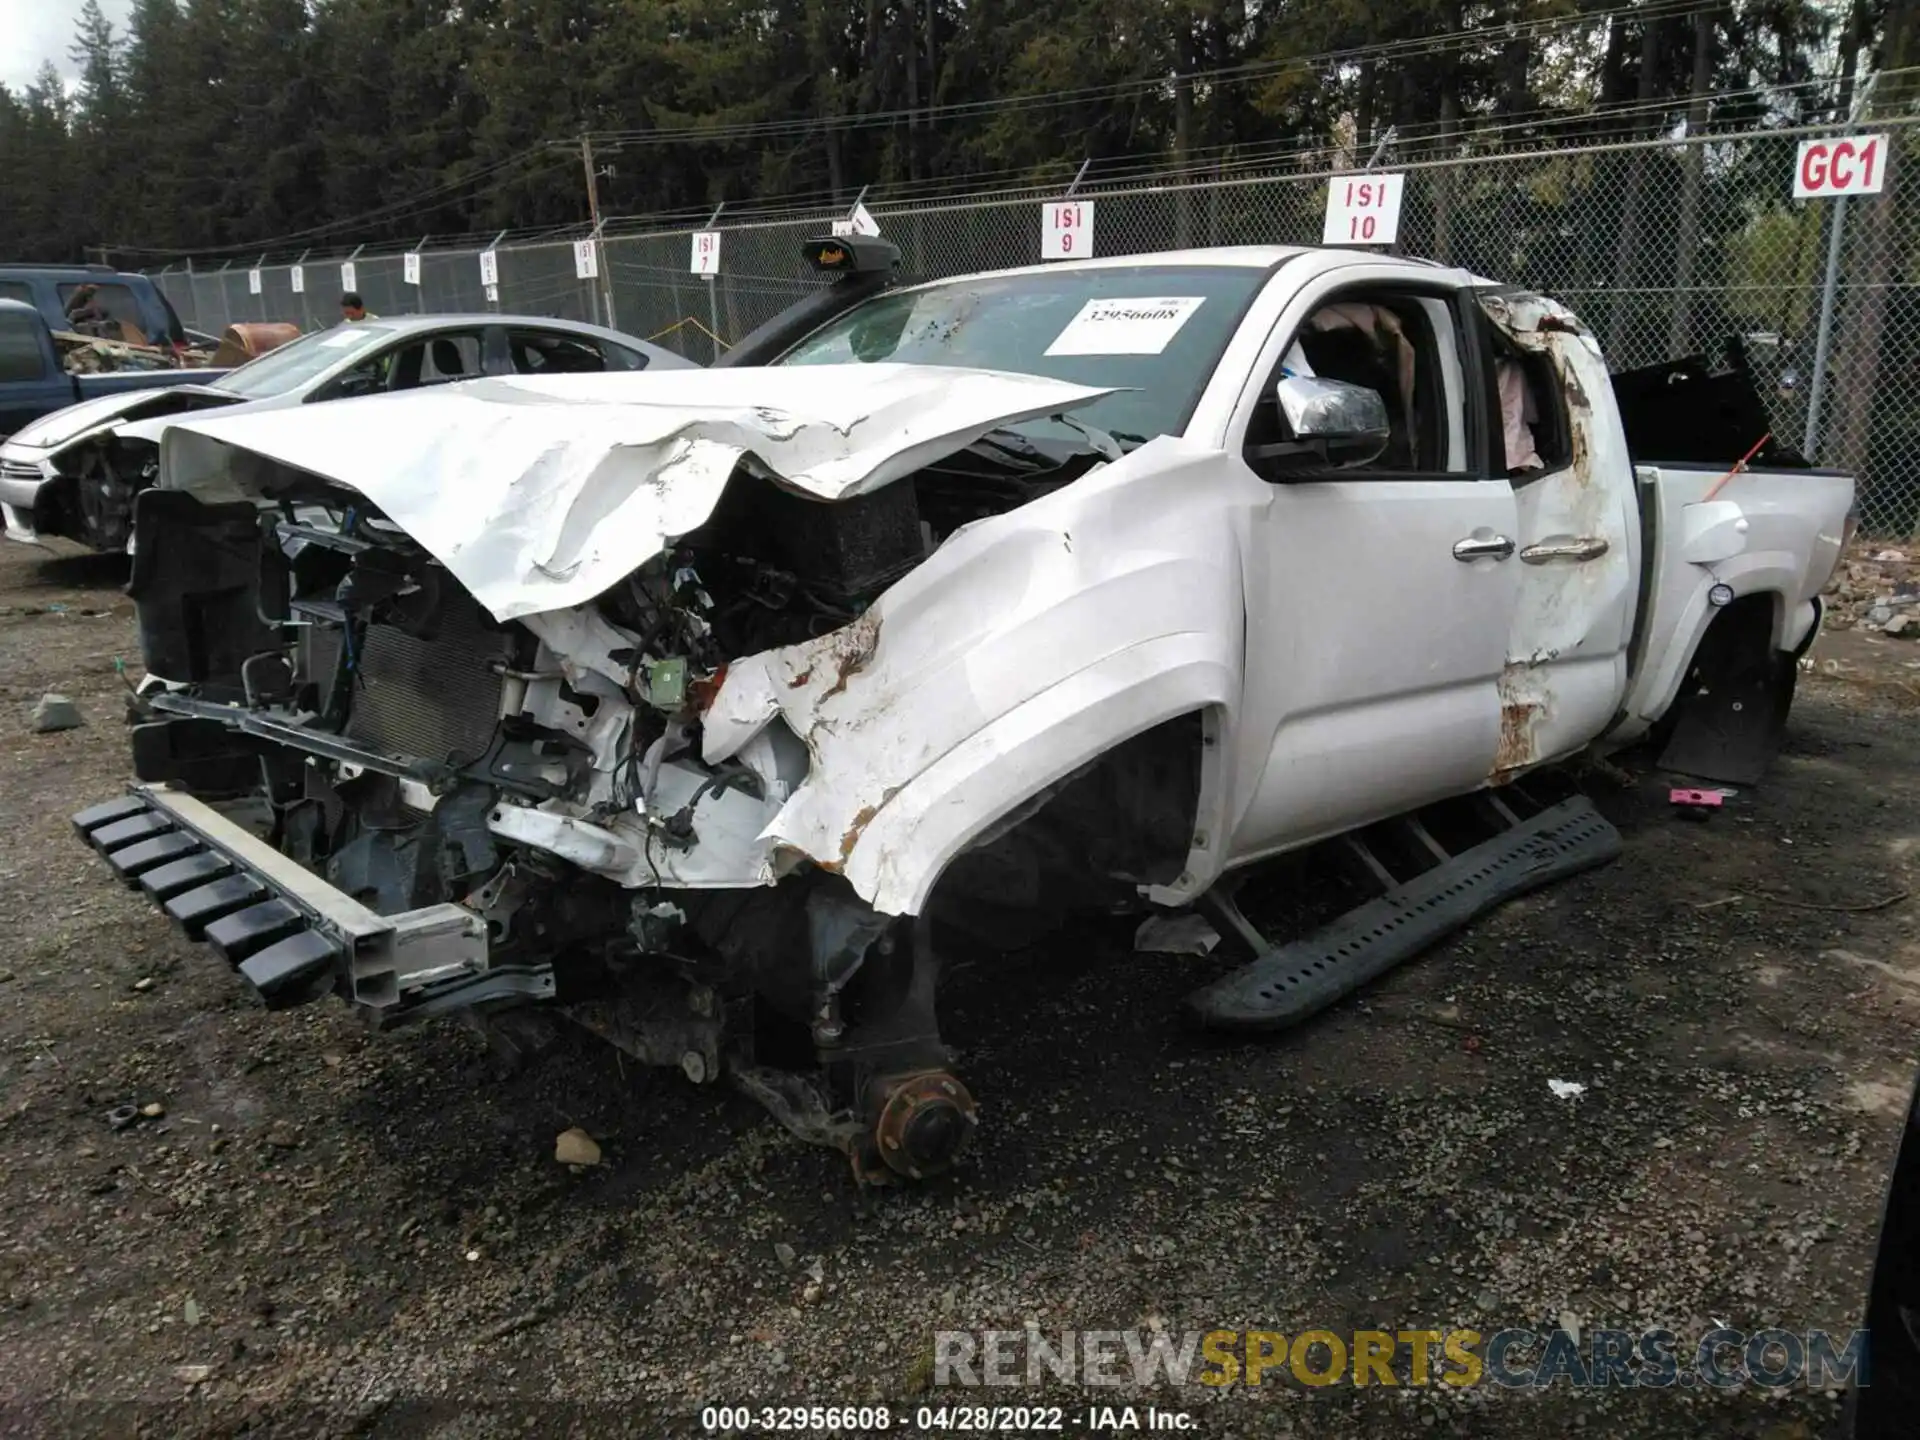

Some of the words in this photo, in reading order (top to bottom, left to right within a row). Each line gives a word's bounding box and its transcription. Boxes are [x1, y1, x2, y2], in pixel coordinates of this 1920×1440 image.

[1802, 139, 1877, 191] GC1
[1350, 215, 1376, 240] 10
[1062, 233, 1073, 252] 9
[700, 255, 709, 272] 7
